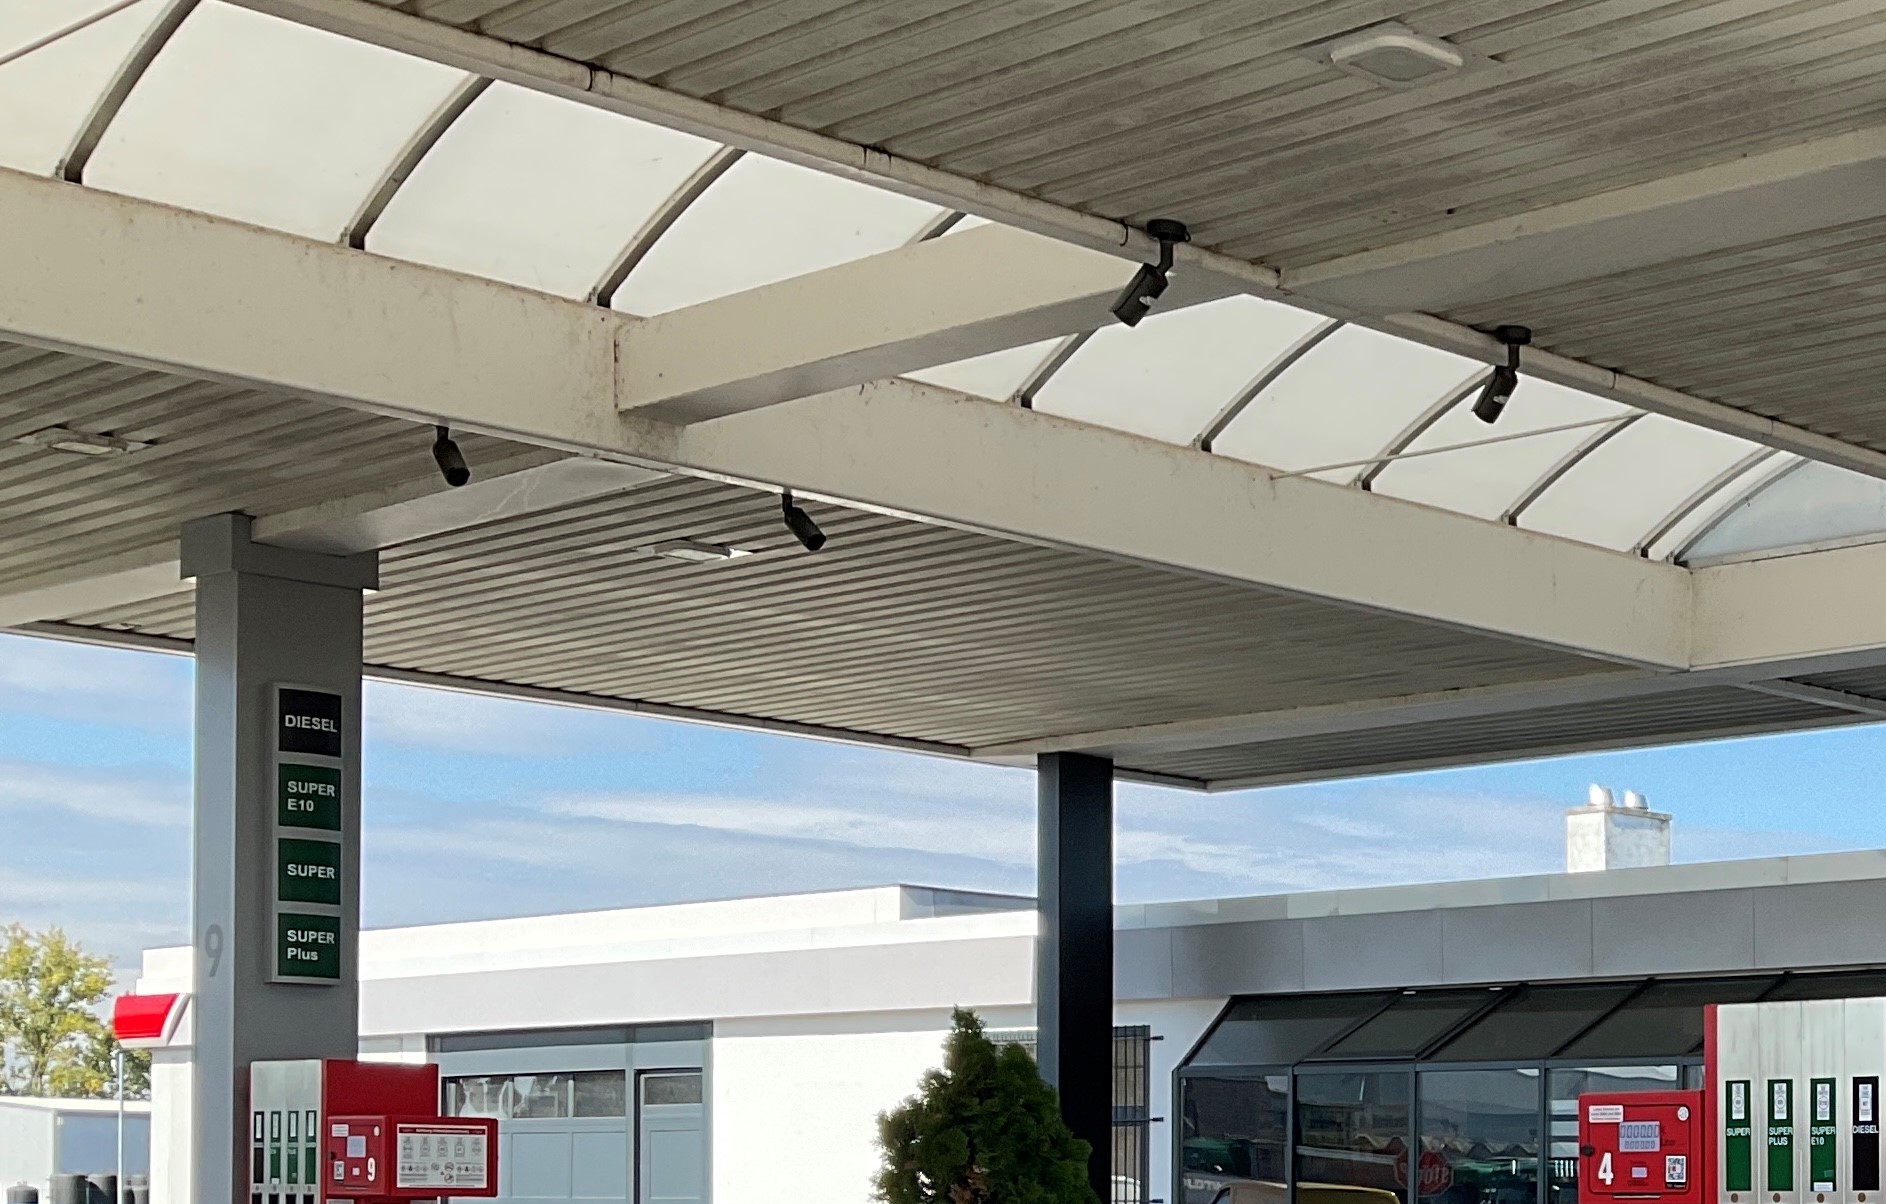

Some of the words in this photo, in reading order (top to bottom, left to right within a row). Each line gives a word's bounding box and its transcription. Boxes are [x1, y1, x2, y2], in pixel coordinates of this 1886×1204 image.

[284, 715, 338, 732] DIESEL
[287, 781, 335, 797] SUPER
[287, 799, 314, 811] E10
[287, 863, 335, 879] SUPER
[287, 929, 335, 944] SUPER
[204, 923, 224, 978] 9
[287, 948, 318, 960] Plus
[1726, 1127, 1751, 1136] SUPER
[1768, 1126, 1793, 1135] SUPER
[1811, 1126, 1836, 1135] SUPER
[1852, 1124, 1879, 1134] DIESEL
[1768, 1137, 1788, 1146] PLUS
[1811, 1137, 1825, 1146] E10
[367, 1157, 376, 1182] 9
[1598, 1152, 1614, 1186] 4
